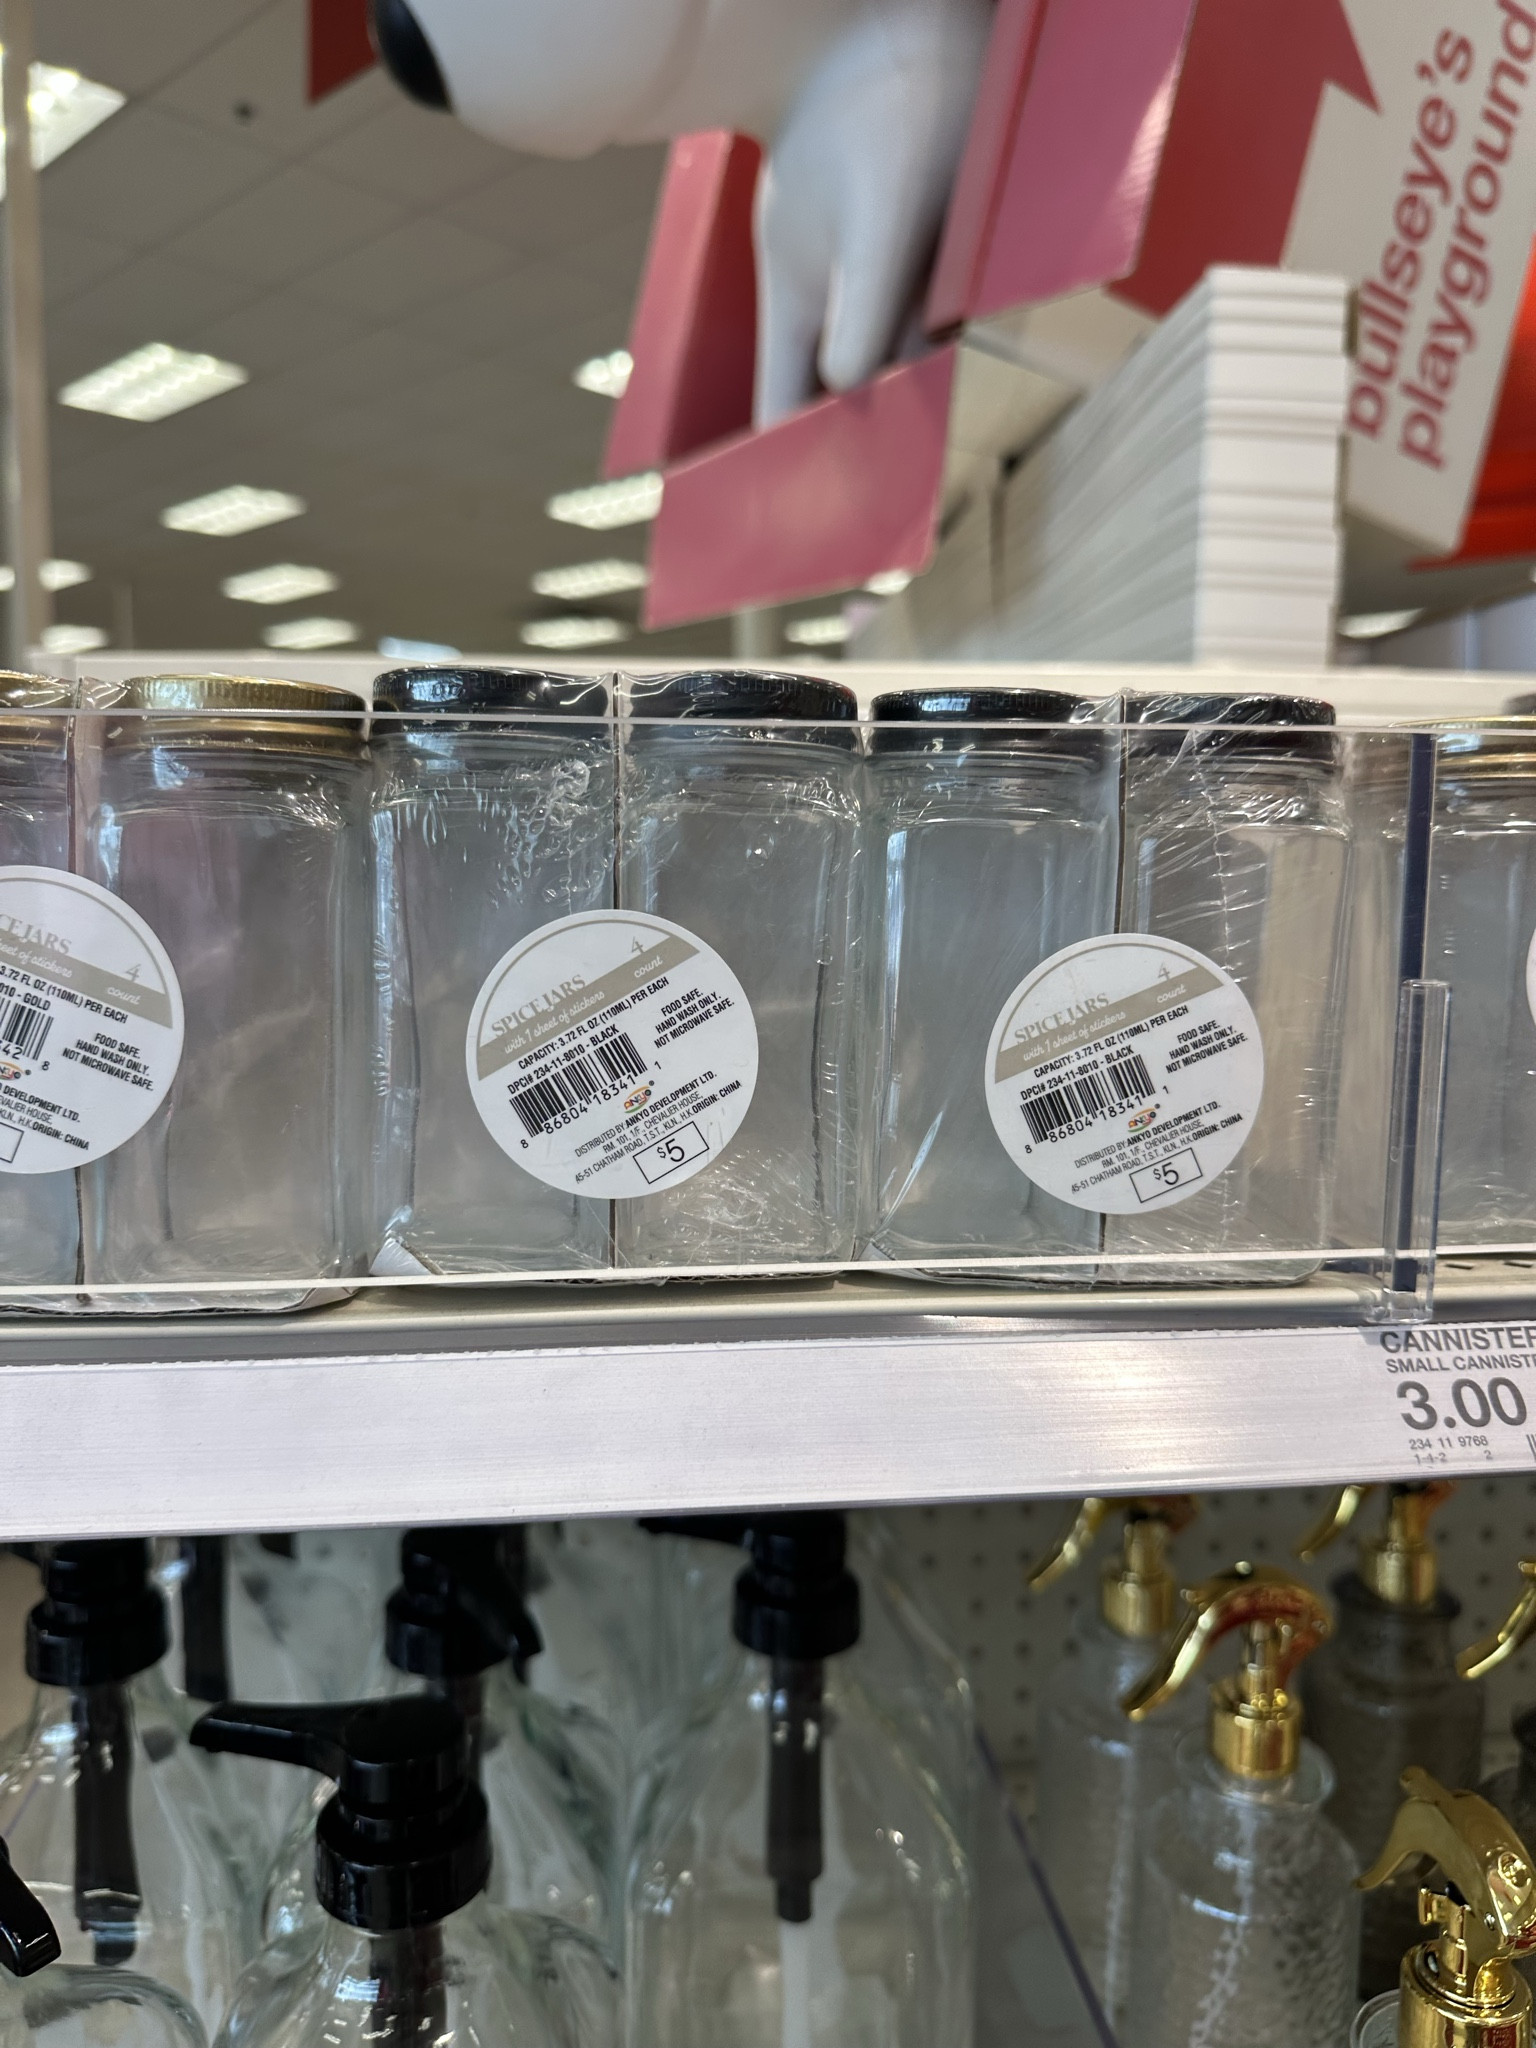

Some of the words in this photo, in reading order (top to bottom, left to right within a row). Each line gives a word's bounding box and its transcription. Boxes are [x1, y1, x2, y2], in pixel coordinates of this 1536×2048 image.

[1346, 27, 1475, 438] bullseye's
[1398, 0, 1536, 471] playground
[20, 924, 72, 954] JARS
[631, 936, 643, 954] 4
[31, 956, 73, 978] stickers
[124, 963, 142, 981] 4
[634, 955, 663, 978] count
[1158, 962, 1170, 980] 4
[20, 974, 31, 986] FL
[33, 979, 47, 992] OZ
[47, 985, 84, 1008] (110ML)
[84, 999, 103, 1014] PER
[103, 1007, 129, 1024] EACH
[23, 993, 51, 1011] GOLD
[106, 986, 141, 1005] count
[491, 998, 547, 1037] SPICE
[542, 974, 586, 1012] JARS
[660, 999, 682, 1017] FOOD
[681, 988, 704, 1005] SAFE.
[1157, 984, 1187, 1003] count
[504, 1035, 526, 1054] with
[534, 1017, 559, 1036] sheet
[559, 1009, 570, 1024] of
[570, 992, 604, 1016] stickers
[518, 1042, 560, 1069] CAPACITY:
[558, 1030, 578, 1047] 3.72
[577, 1025, 588, 1036] FL
[587, 1017, 600, 1029] OZ
[600, 999, 632, 1025] (110ML)
[630, 989, 648, 1004] PER
[647, 976, 670, 995] EACH
[654, 1034, 671, 1048] NOT
[669, 1008, 715, 1040] MICROWAVE
[712, 998, 735, 1014] SAFE.
[655, 1017, 677, 1034] HAND
[676, 1003, 700, 1022] WASH
[698, 992, 722, 1010] ONLY.
[1014, 1011, 1068, 1045] SPICE
[1067, 992, 1109, 1025] JARS
[94, 1033, 118, 1048] FOOD
[118, 1042, 141, 1059] SAFE.
[1023, 1043, 1045, 1062] with
[1052, 1030, 1078, 1048] sheet
[1078, 1024, 1089, 1039] of
[1089, 1011, 1126, 1032] stickers
[1034, 1055, 1075, 1078] CAPACITY:
[1075, 1046, 1094, 1060] 3.72
[1093, 1041, 1104, 1053] FL
[1105, 1036, 1117, 1047] OZ
[1117, 1021, 1150, 1044] (110ML)
[1150, 1015, 1167, 1028] PER
[1167, 1005, 1189, 1021] EACH
[1169, 1044, 1190, 1060] HAND
[1190, 1035, 1214, 1050] WASH
[1214, 1025, 1237, 1041] ONLY.
[1177, 1028, 1198, 1044] FOOD
[1198, 1020, 1221, 1035] SAFE.
[42, 1061, 50, 1071] 8
[62, 1048, 81, 1061] NOT
[80, 1054, 131, 1082] MICROWAVE
[131, 1074, 154, 1091] SAFE.
[76, 1039, 99, 1055] HAND
[101, 1048, 125, 1065] WASH
[126, 1059, 150, 1076] ONLY.
[507, 1074, 534, 1094] DPCI#
[534, 1044, 586, 1080] 234-11-8010
[590, 1024, 620, 1046] BLACK
[1166, 1060, 1181, 1074] NOT
[1182, 1041, 1227, 1067] MICROWAVE
[1227, 1033, 1248, 1047] SAFE.
[1020, 1083, 1046, 1100] DPCI#
[1046, 1061, 1099, 1089] 234-11-8010
[1104, 1045, 1134, 1065] BLACK
[3, 1085, 64, 1115] DEVELOPMENT
[62, 1106, 81, 1123] LTD.
[574, 1129, 616, 1157] DISTRIBUTED
[649, 1079, 700, 1114] DEVELOPMENT
[699, 1071, 718, 1084] LTD.
[644, 1104, 680, 1129] CHEVALIER
[65, 1133, 90, 1150] CHINA
[592, 1151, 625, 1172] CHATHAM
[719, 1079, 742, 1098] CHINA
[1074, 1145, 1116, 1169] DISTRIBUTED
[1152, 1107, 1203, 1135] DEVELOPMENT
[1203, 1101, 1221, 1113] LTD.
[1145, 1130, 1180, 1150] CHEVALIER
[520, 1139, 529, 1149] 8
[656, 1138, 685, 1162] $5
[1025, 1144, 1032, 1154] 8
[1089, 1165, 1122, 1185] CHATHAM
[1220, 1113, 1243, 1129] CHINA
[1153, 1162, 1179, 1185] $5
[1385, 1357, 1450, 1374] SMALL
[1396, 1377, 1527, 1430] 3.00
[1409, 1438, 1432, 1450] 234
[1438, 1437, 1452, 1448] 11
[1458, 1435, 1488, 1448] 9768
